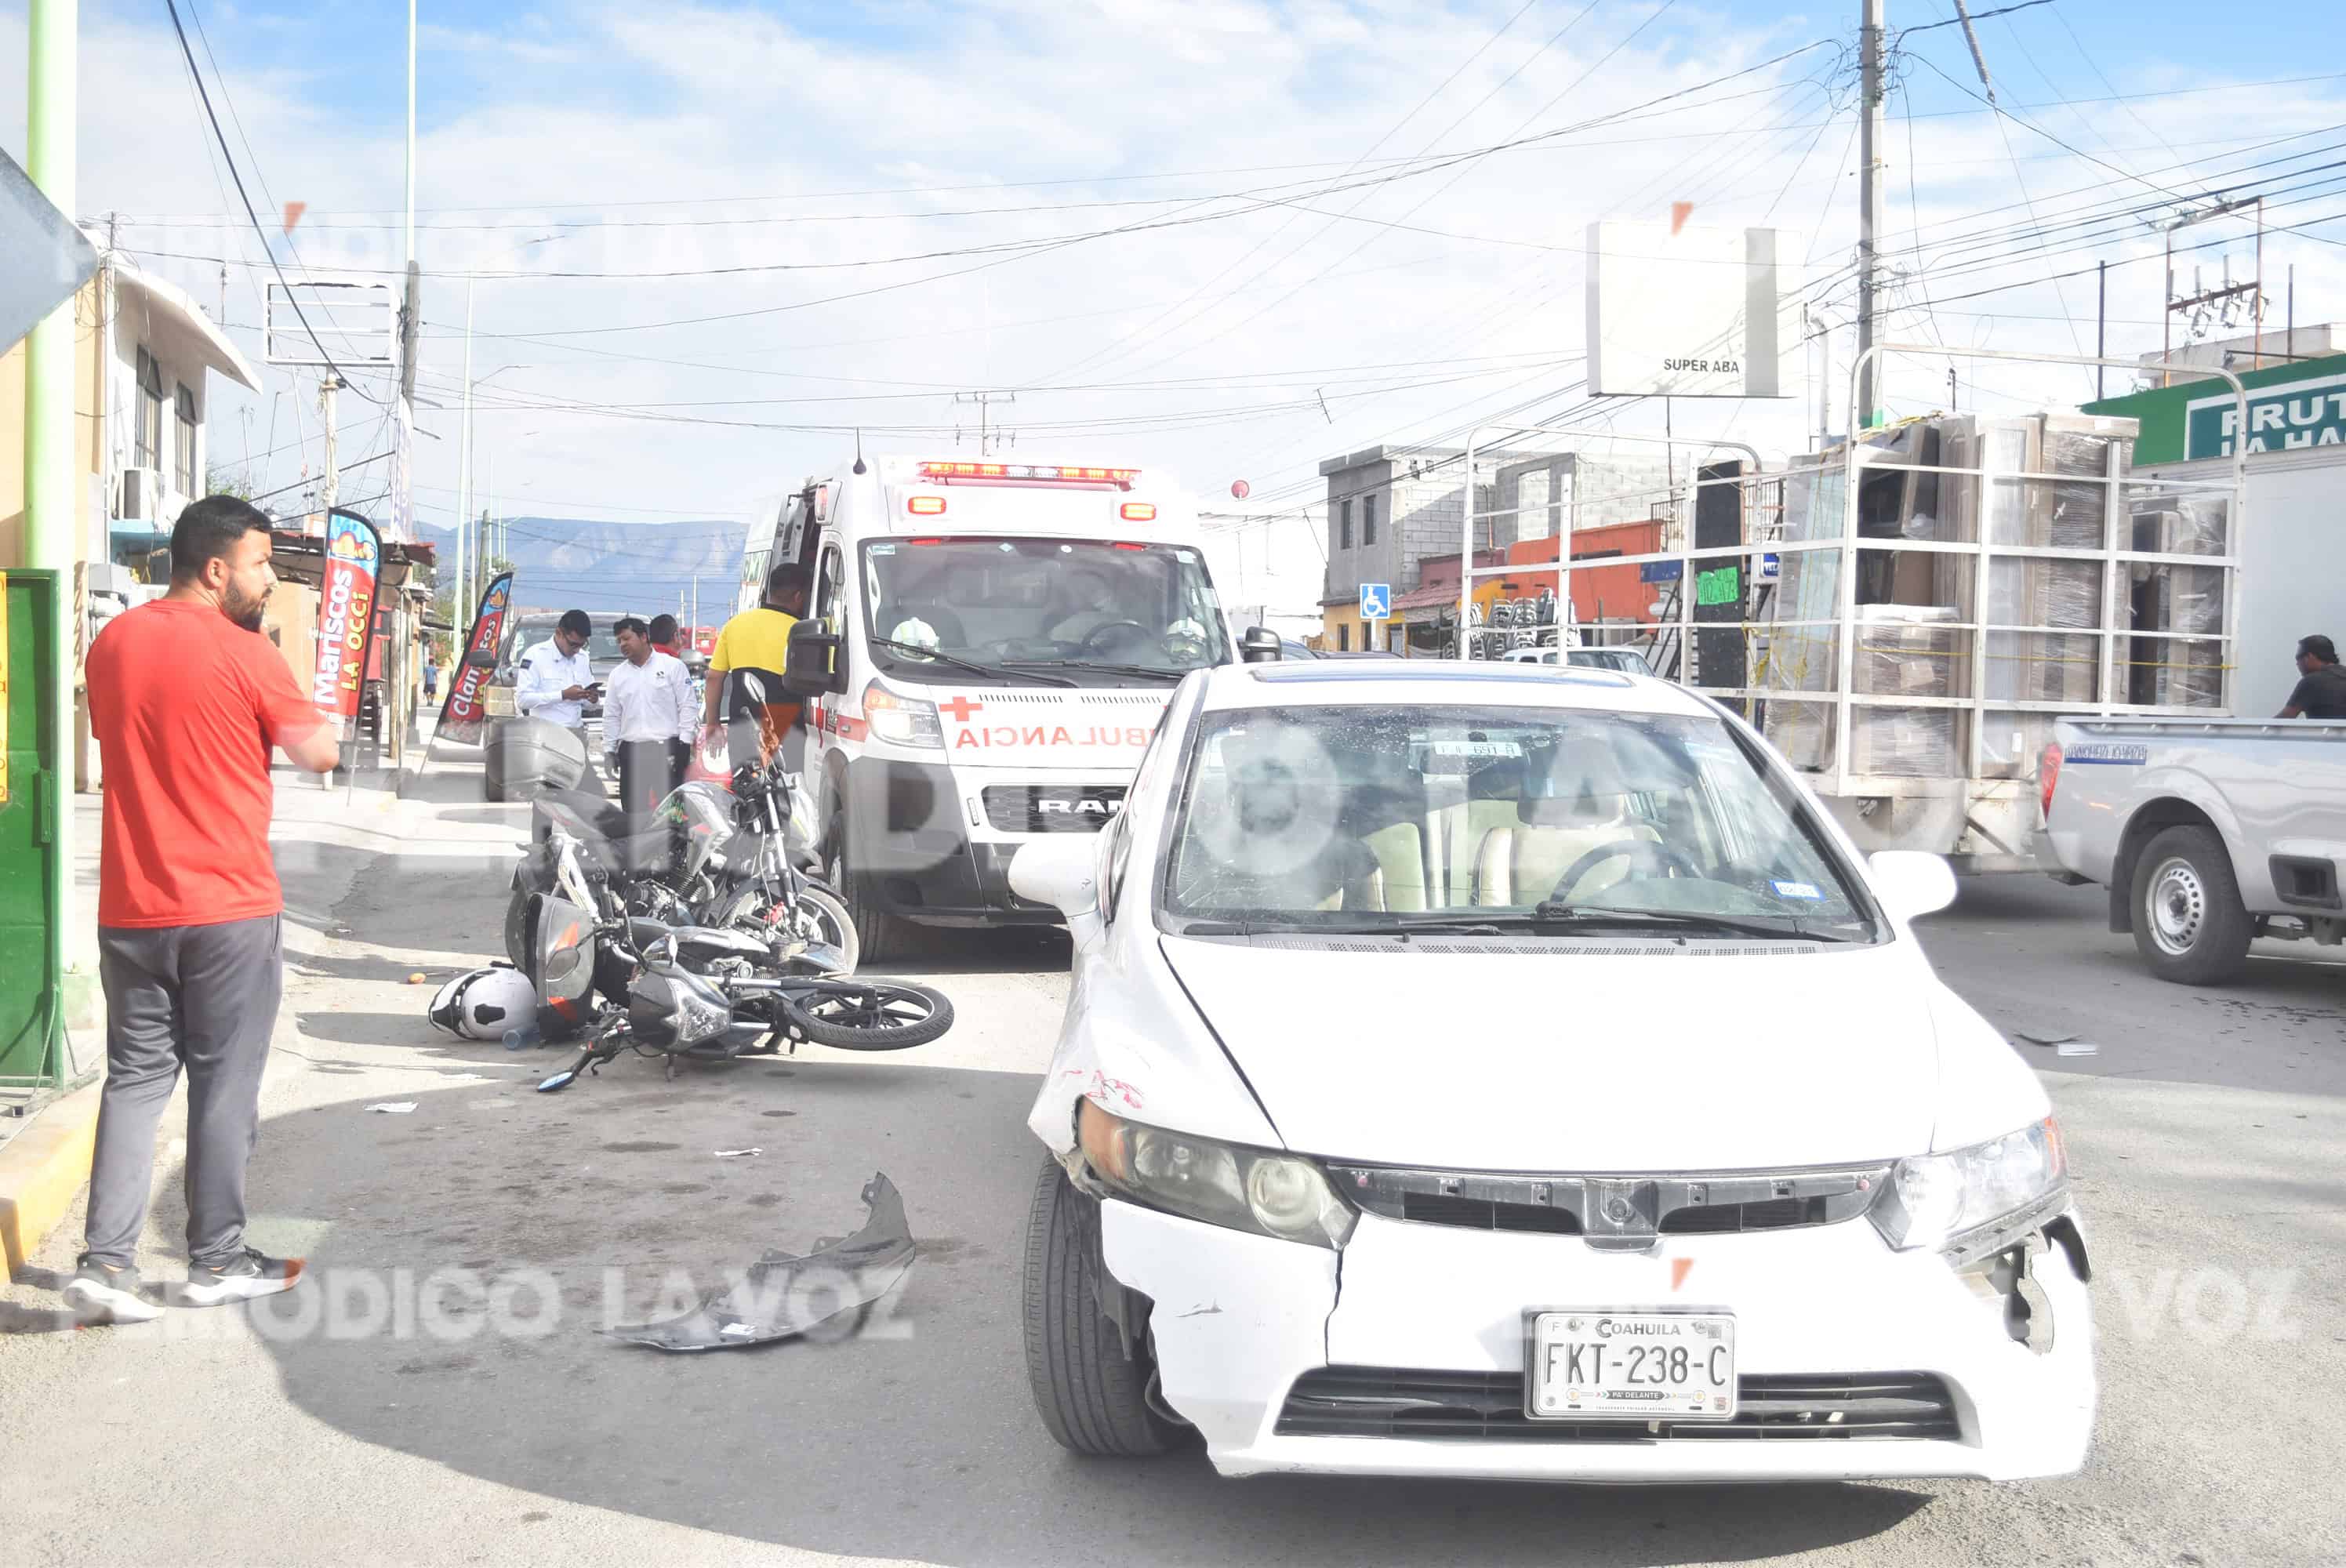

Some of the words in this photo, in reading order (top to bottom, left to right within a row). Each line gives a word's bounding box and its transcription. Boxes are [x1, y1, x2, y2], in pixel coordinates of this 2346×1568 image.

[1663, 358, 1709, 372] SUPER
[1712, 360, 1739, 373] ABA
[313, 568, 353, 705] Mariscos
[341, 661, 360, 691] LA
[452, 619, 496, 717] Clamtos
[1595, 1319, 1681, 1338] COAHUILA
[1545, 1342, 1727, 1386] FKT-238-C
